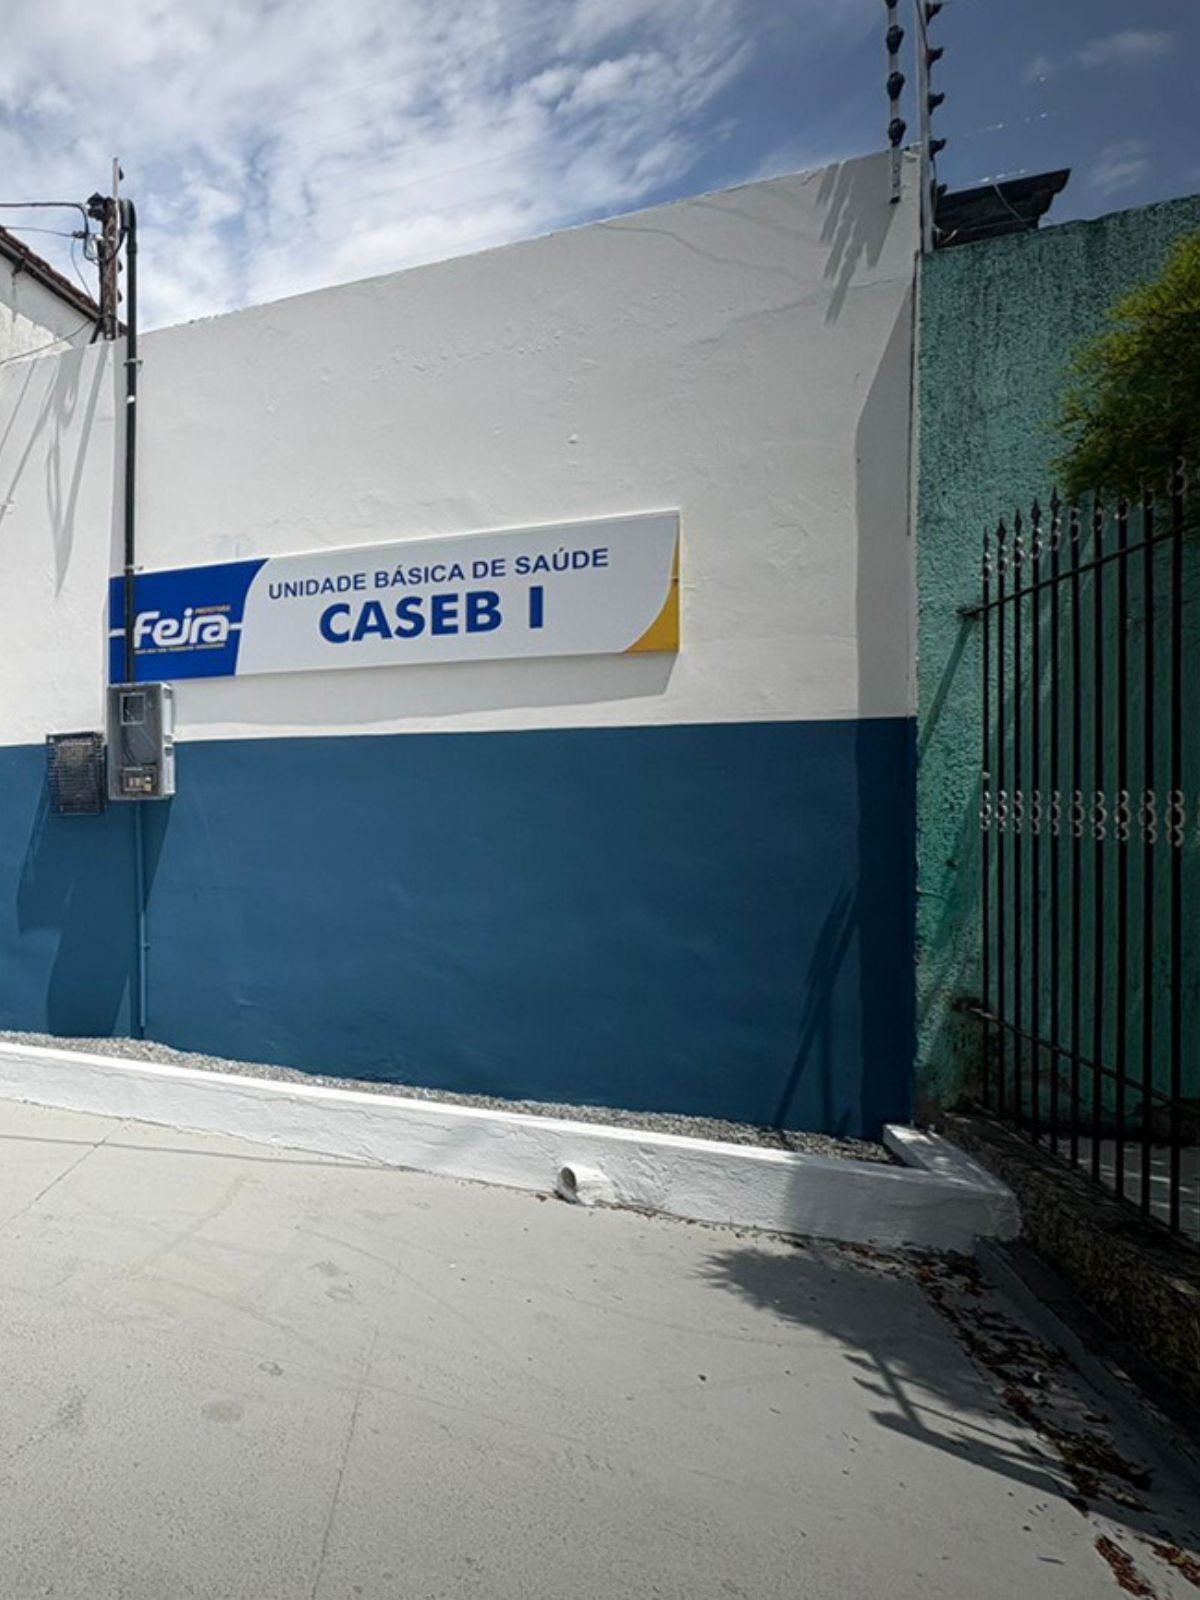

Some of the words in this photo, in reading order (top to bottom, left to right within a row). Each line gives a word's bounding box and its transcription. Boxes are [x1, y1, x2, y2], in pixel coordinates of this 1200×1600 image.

[268, 573, 367, 600] UNIDADE
[374, 563, 465, 588] BÁSICA
[472, 559, 506, 579] DE
[515, 547, 609, 575] SAÚDE
[319, 590, 502, 644] CASEB
[529, 585, 544, 629] I
